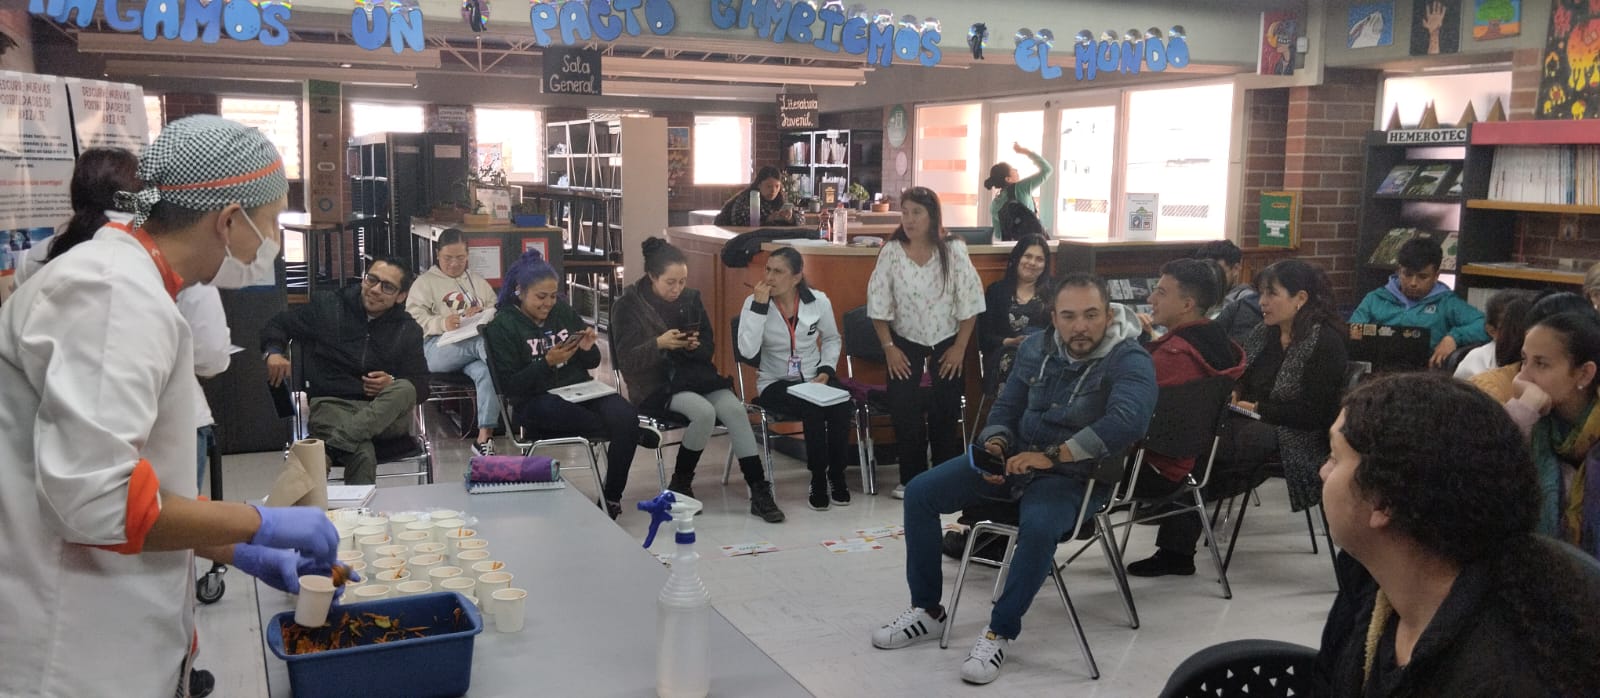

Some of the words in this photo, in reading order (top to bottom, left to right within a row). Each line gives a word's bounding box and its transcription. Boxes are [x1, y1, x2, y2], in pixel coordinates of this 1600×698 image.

[351, 6, 426, 54] UN
[530, 0, 676, 46] PACTO
[711, 0, 942, 67] CAMBIEMOS
[1014, 37, 1063, 80] EL
[1074, 37, 1190, 81] MUNDO
[562, 54, 590, 74] Sala
[779, 95, 818, 110] Literatura
[1389, 130, 1466, 142] HEMEROTEC
